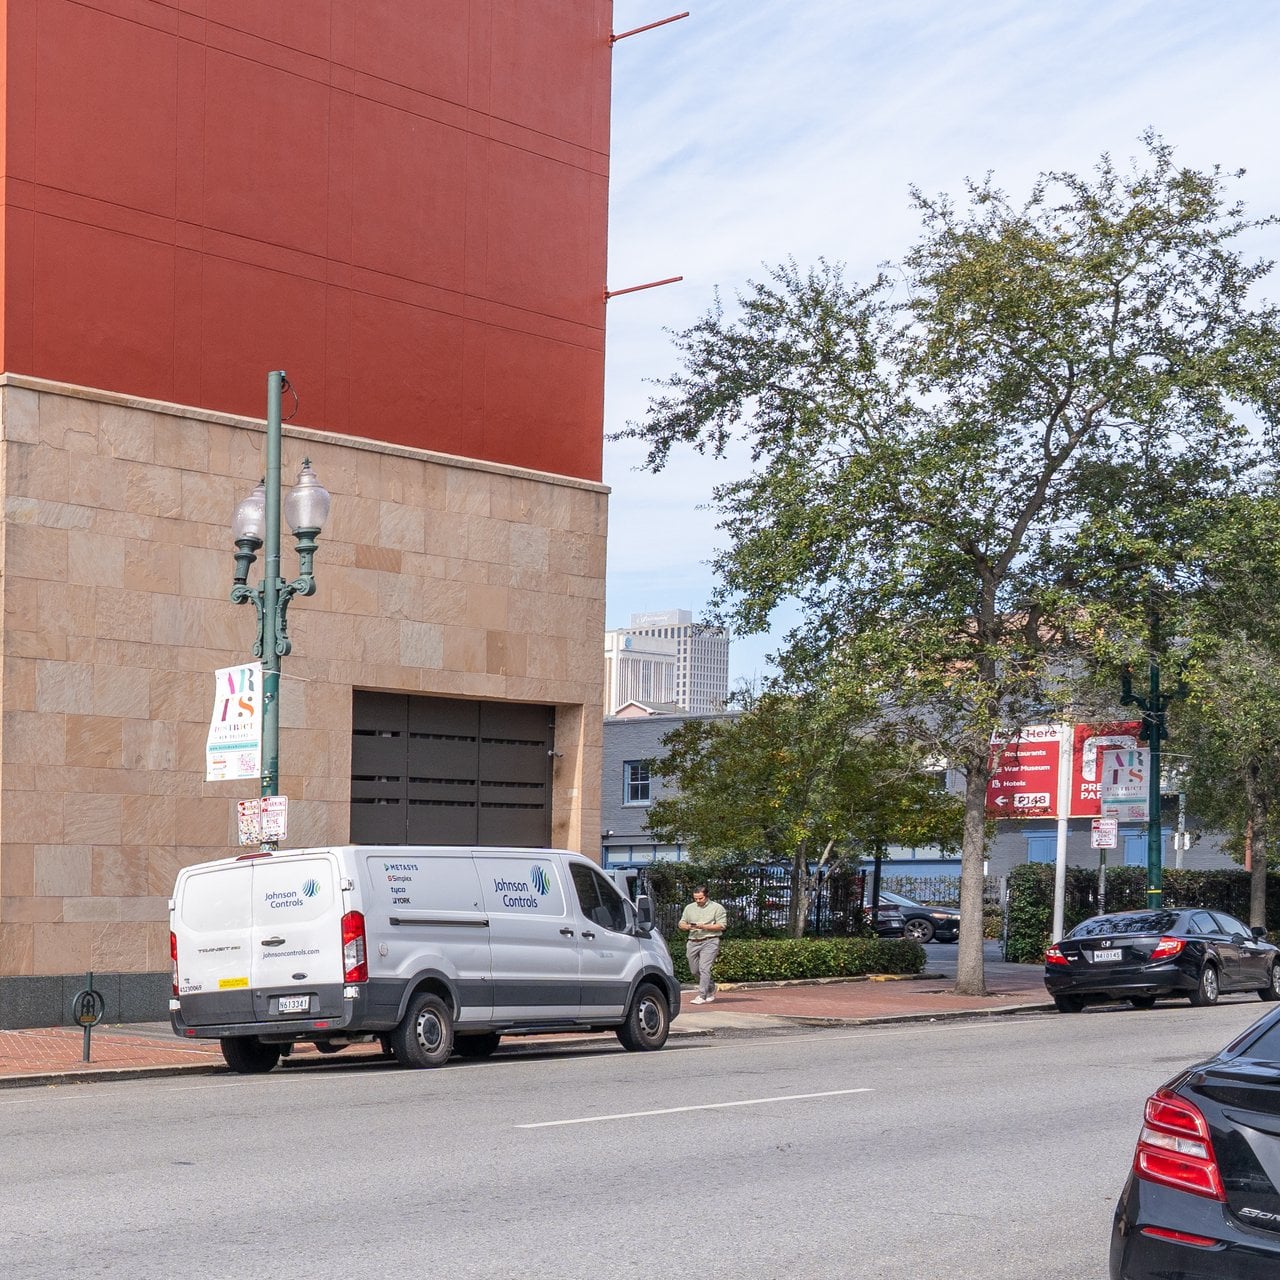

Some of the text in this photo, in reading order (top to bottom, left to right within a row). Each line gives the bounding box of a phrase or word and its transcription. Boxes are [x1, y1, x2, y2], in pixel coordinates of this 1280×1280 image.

[1026, 728, 1058, 739] Here
[1004, 764, 1051, 773] War Museum
[1003, 779, 1027, 787] Hotels
[390, 886, 406, 894] tyco
[493, 878, 529, 893] Johnson
[264, 890, 297, 901] Johnson
[502, 894, 538, 908] Controls
[270, 898, 304, 909] Controls
[262, 948, 320, 959] johnsoncontrols.com
